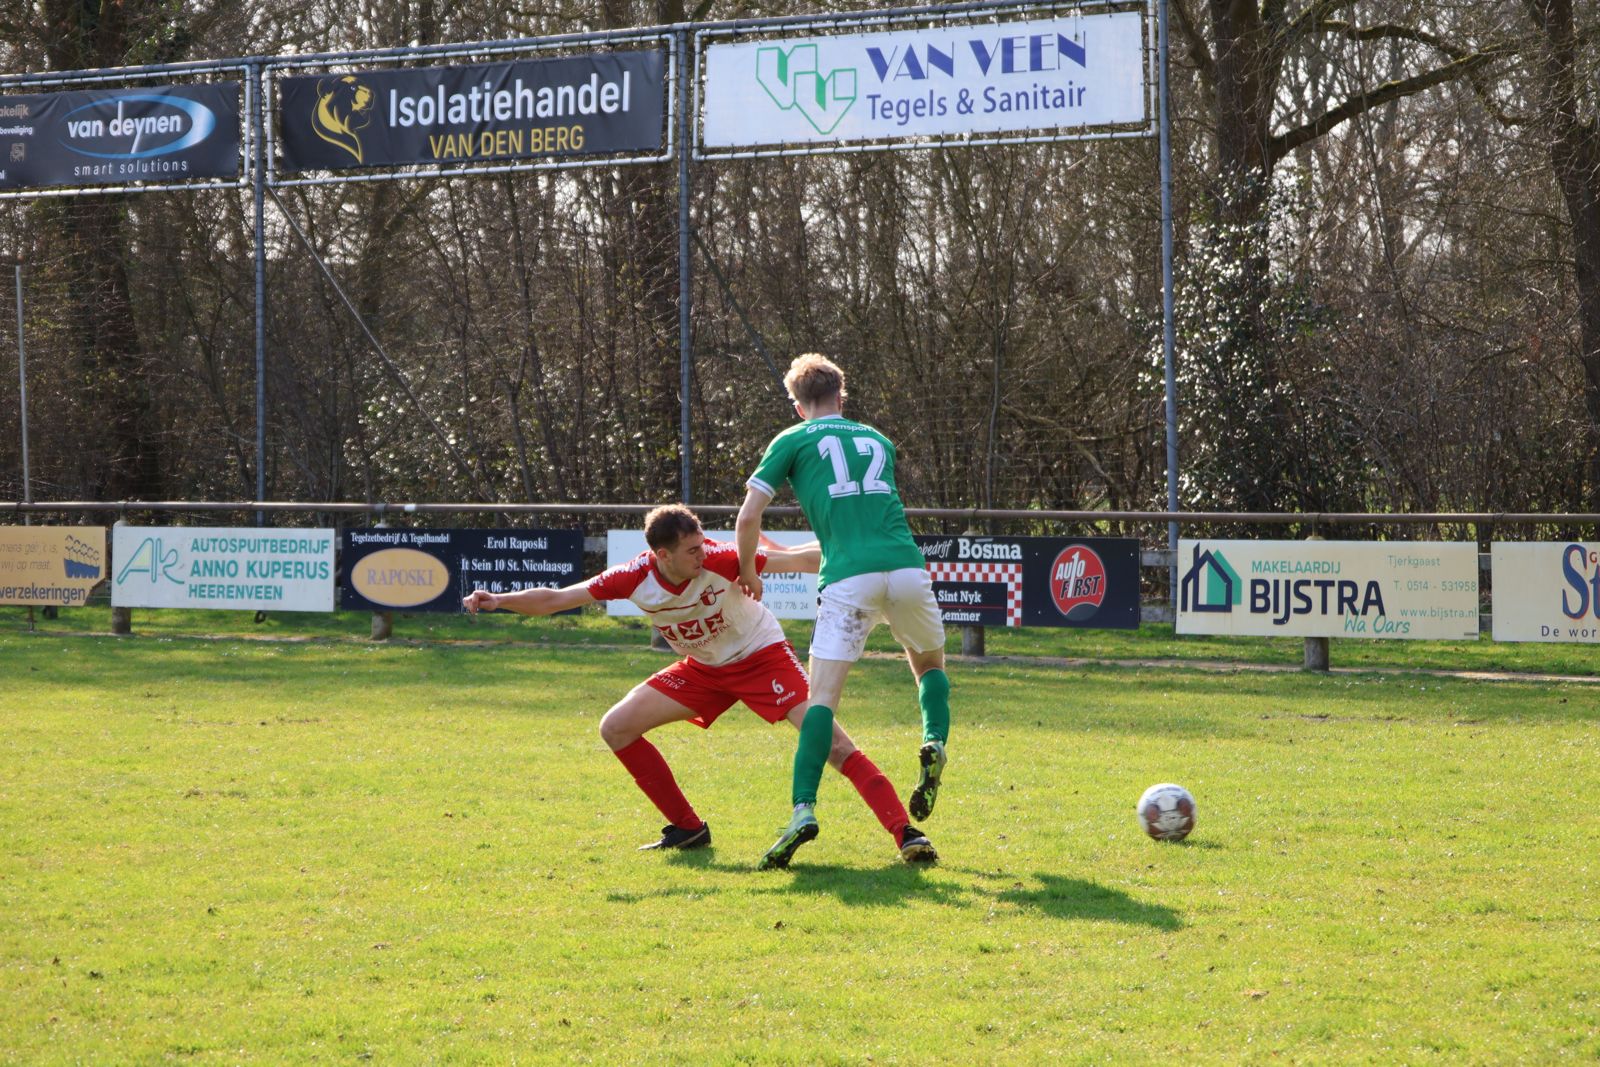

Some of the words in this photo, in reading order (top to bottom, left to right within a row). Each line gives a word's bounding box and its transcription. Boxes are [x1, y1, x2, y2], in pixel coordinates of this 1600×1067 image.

[865, 41, 955, 83] VAN
[968, 31, 1087, 77] VEEN
[389, 71, 631, 127] Isolatiehandel
[866, 89, 948, 125] Tegels
[957, 88, 974, 115] &
[983, 80, 1087, 113] Sanitair
[68, 120, 103, 138] van
[109, 100, 182, 155] deynen
[430, 133, 475, 159] VAN
[481, 130, 523, 155] DEN
[531, 125, 584, 152] BERG
[74, 162, 113, 176] smart
[119, 158, 188, 174] solutions
[816, 435, 892, 499] 12
[190, 538, 330, 554] AUTOSPUITBEDRIJF
[401, 533, 408, 543] &
[409, 533, 450, 545] Tegelhandel
[487, 537, 506, 549] Erol
[509, 537, 547, 551] Raposki
[957, 537, 1022, 560] Bosma
[190, 559, 239, 578] ANNO
[246, 560, 329, 580] KUPERUS
[471, 559, 491, 571] Sein
[495, 559, 505, 571] 10
[507, 559, 520, 572] St.
[522, 559, 573, 575] Nicolaasga
[1251, 560, 1341, 574] MAKELAARDIJ
[1387, 555, 1440, 568] Tjerkgaast
[367, 568, 434, 586] RAPOSKI
[0, 582, 86, 604] verzekeringen
[189, 584, 283, 600] HEERENVEEN
[491, 581, 502, 593] 06
[774, 583, 808, 593] POSTMA
[1407, 581, 1429, 591] 0514
[1441, 581, 1477, 592] 531958
[938, 590, 958, 602] Sint
[960, 591, 982, 604] Nyk
[1250, 578, 1386, 625] BIJSTRA
[939, 609, 981, 622] Lemmer
[1400, 606, 1478, 620] www.bijstra.nl
[1372, 614, 1410, 634] Oars
[1541, 625, 1560, 637] De
[1569, 628, 1597, 638] wor
[771, 678, 784, 695] 6
